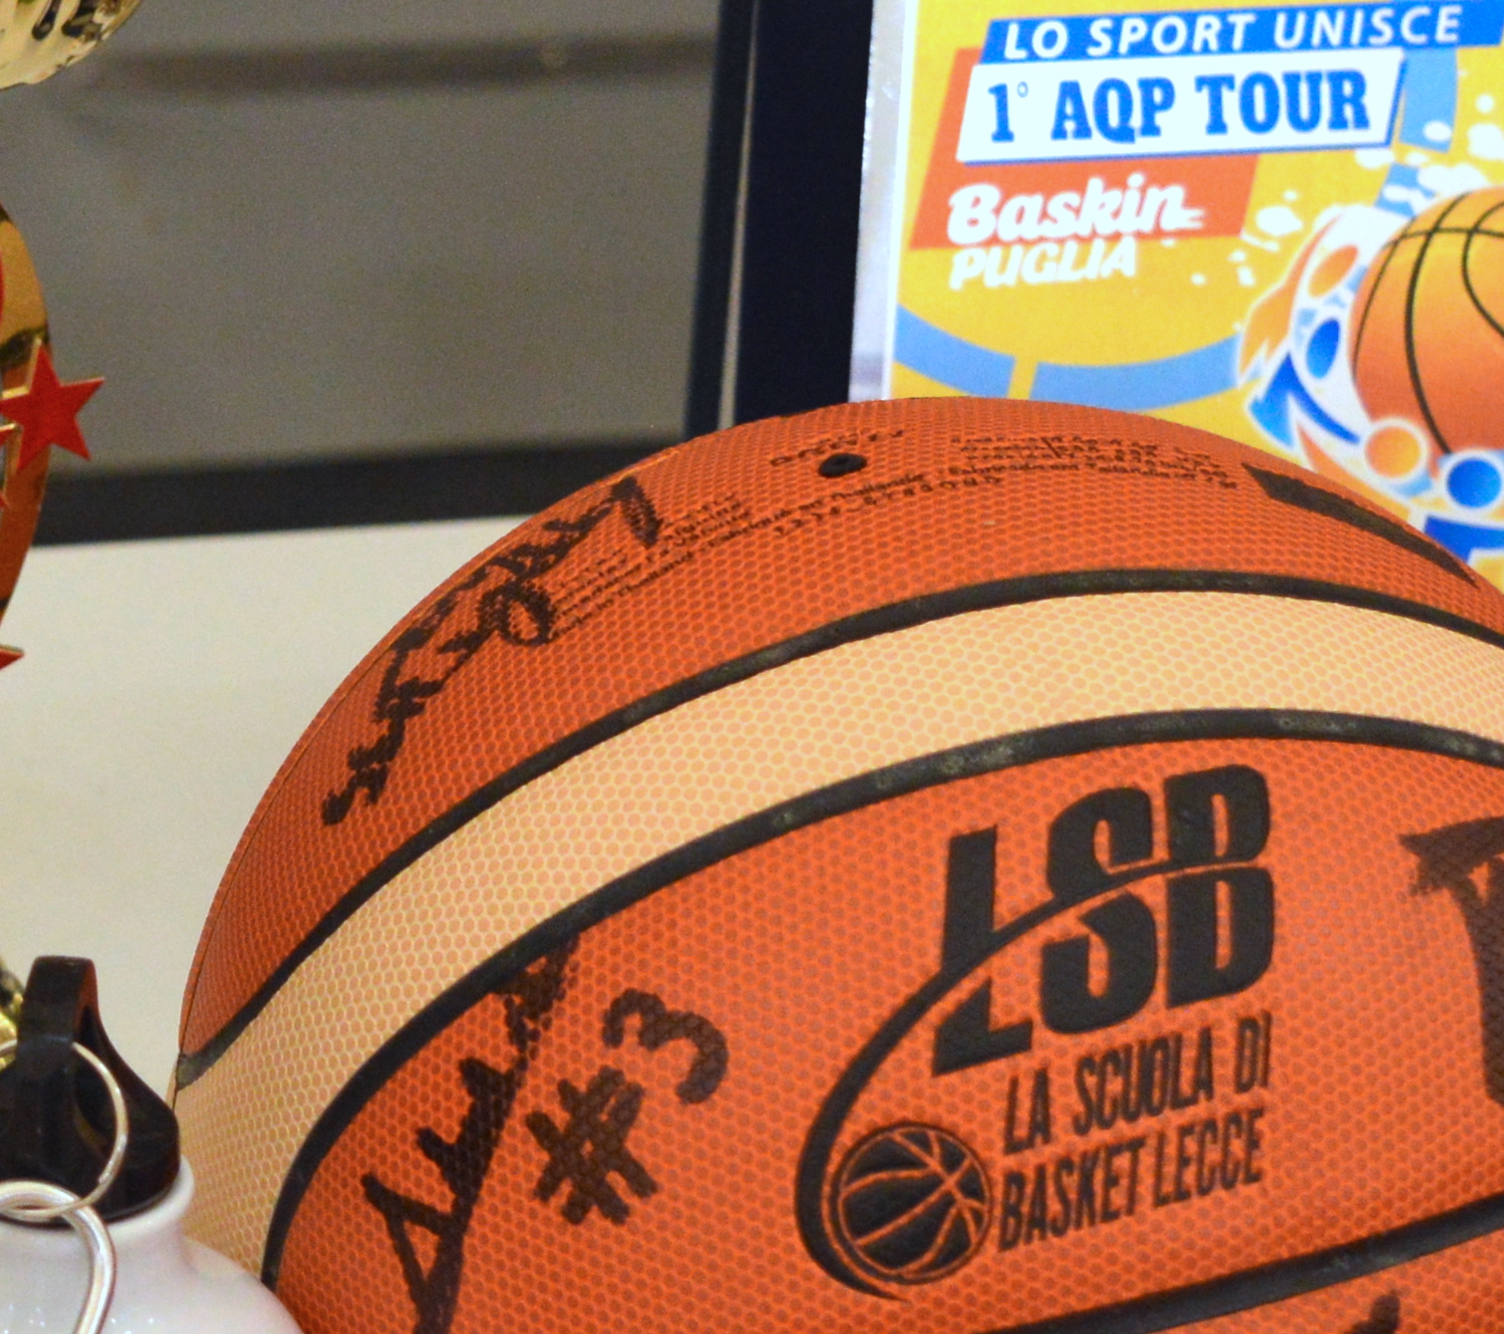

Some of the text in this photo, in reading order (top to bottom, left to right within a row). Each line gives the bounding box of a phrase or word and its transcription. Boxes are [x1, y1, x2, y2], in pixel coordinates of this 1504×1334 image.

[1003, 4, 1464, 60] LO SPORT UNISCE
[1050, 77, 1177, 144] AQP
[1195, 68, 1371, 135] TOUR
[947, 172, 1197, 244] Baskin
[948, 235, 1137, 290] PUGLIA
[932, 763, 1275, 1077] LSB
[1003, 1009, 1273, 1156] LA SCUOLA DI
[998, 1107, 1265, 1253] BASKET LECCE
